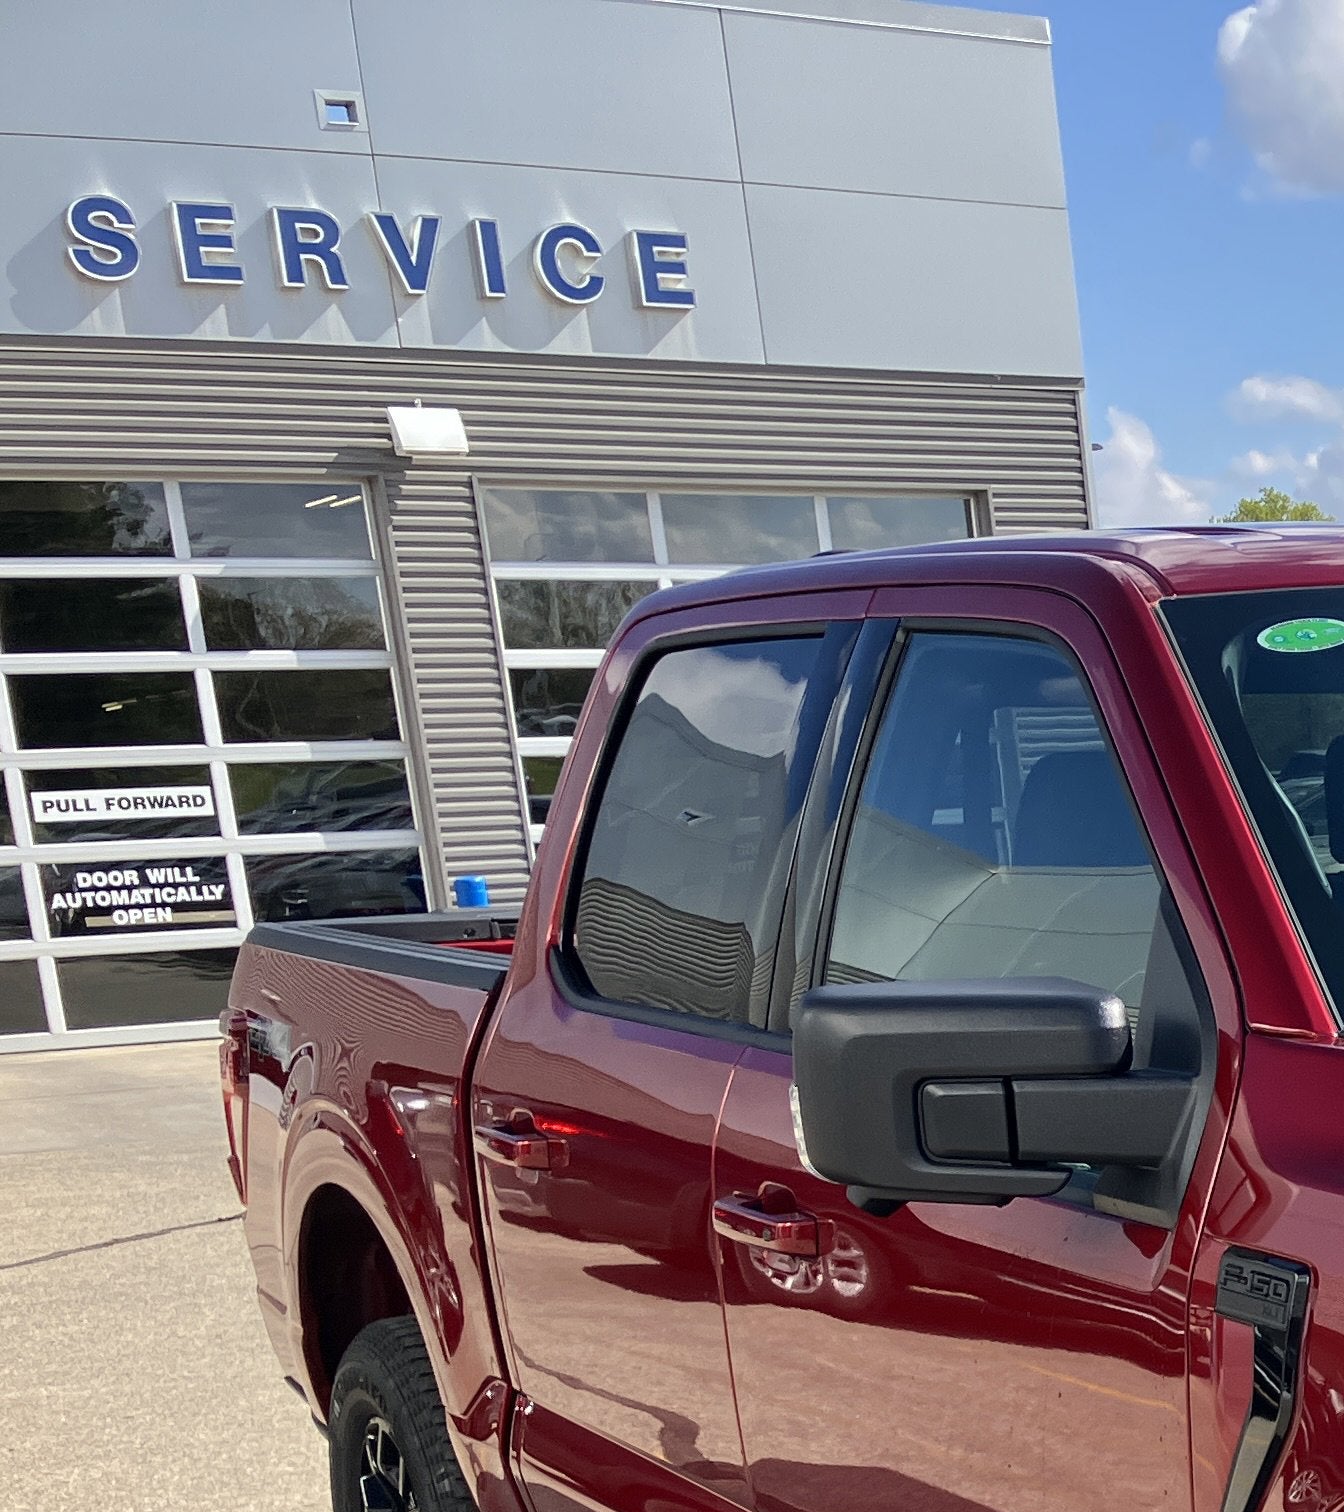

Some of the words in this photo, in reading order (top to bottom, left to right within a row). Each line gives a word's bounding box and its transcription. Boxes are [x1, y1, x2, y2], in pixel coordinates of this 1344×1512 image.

[66, 194, 697, 310] SERVICE
[42, 798, 97, 814] PULL
[105, 794, 207, 811] FORWARD
[76, 870, 139, 888] DOOR
[146, 867, 201, 884] WILL
[51, 884, 225, 910] AUTOMATICALLY
[112, 907, 173, 925] OPEN
